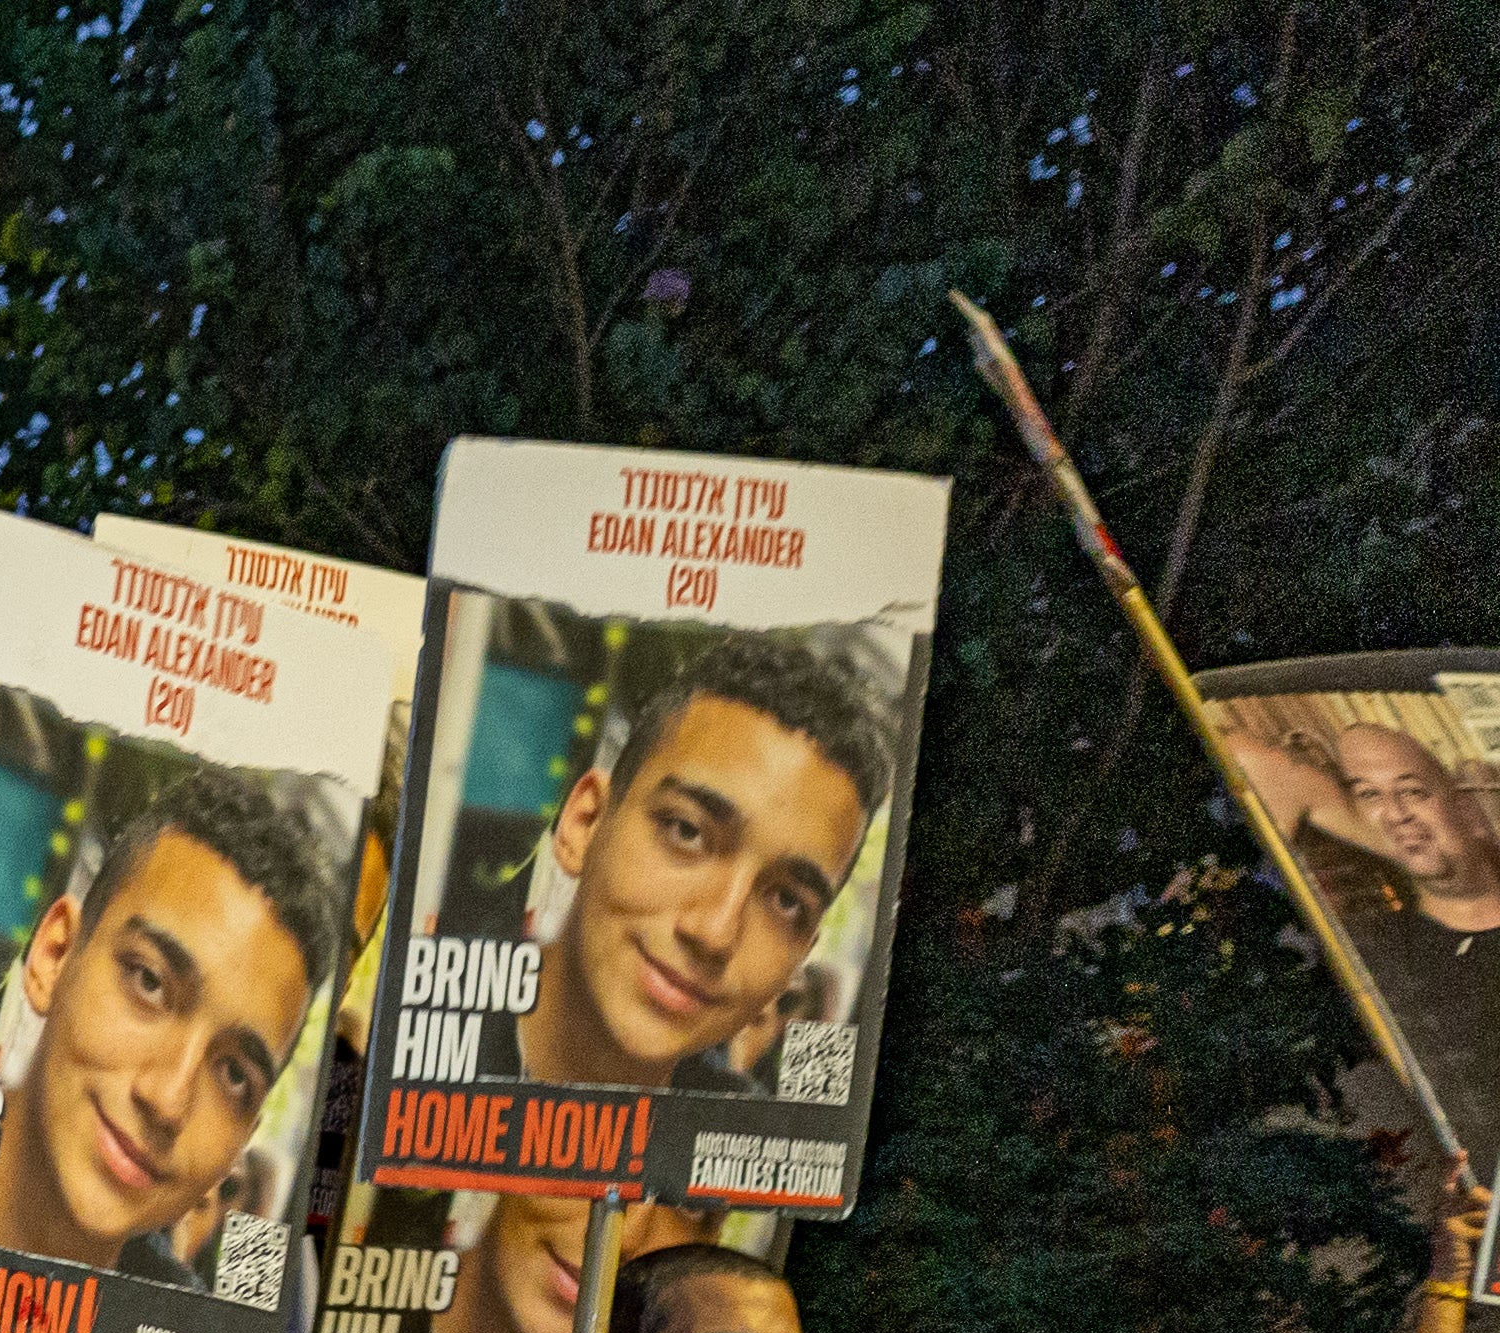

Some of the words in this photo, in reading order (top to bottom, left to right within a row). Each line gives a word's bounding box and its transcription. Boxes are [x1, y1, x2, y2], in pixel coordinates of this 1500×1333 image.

[620, 466, 728, 515] אלכסנדר
[734, 475, 789, 523] עידן
[226, 543, 306, 596] אלכסנדר
[587, 511, 656, 556] EDAN
[659, 516, 806, 570] ALEXANDER
[110, 557, 212, 629] אלכסנדר
[307, 561, 349, 605] עידן
[666, 561, 719, 613] (20)
[213, 590, 265, 646] עידן
[75, 602, 142, 662] EDAN
[142, 622, 278, 705] ALEXANDER
[145, 675, 196, 737] (20)
[403, 936, 541, 1013] BRING
[392, 1008, 482, 1083] HIM
[382, 1088, 514, 1165] HOME
[518, 1096, 652, 1174] NOW!
[690, 1155, 775, 1195] FAMILIES
[775, 1161, 844, 1200] FORUM
[326, 1246, 459, 1312] BRING
